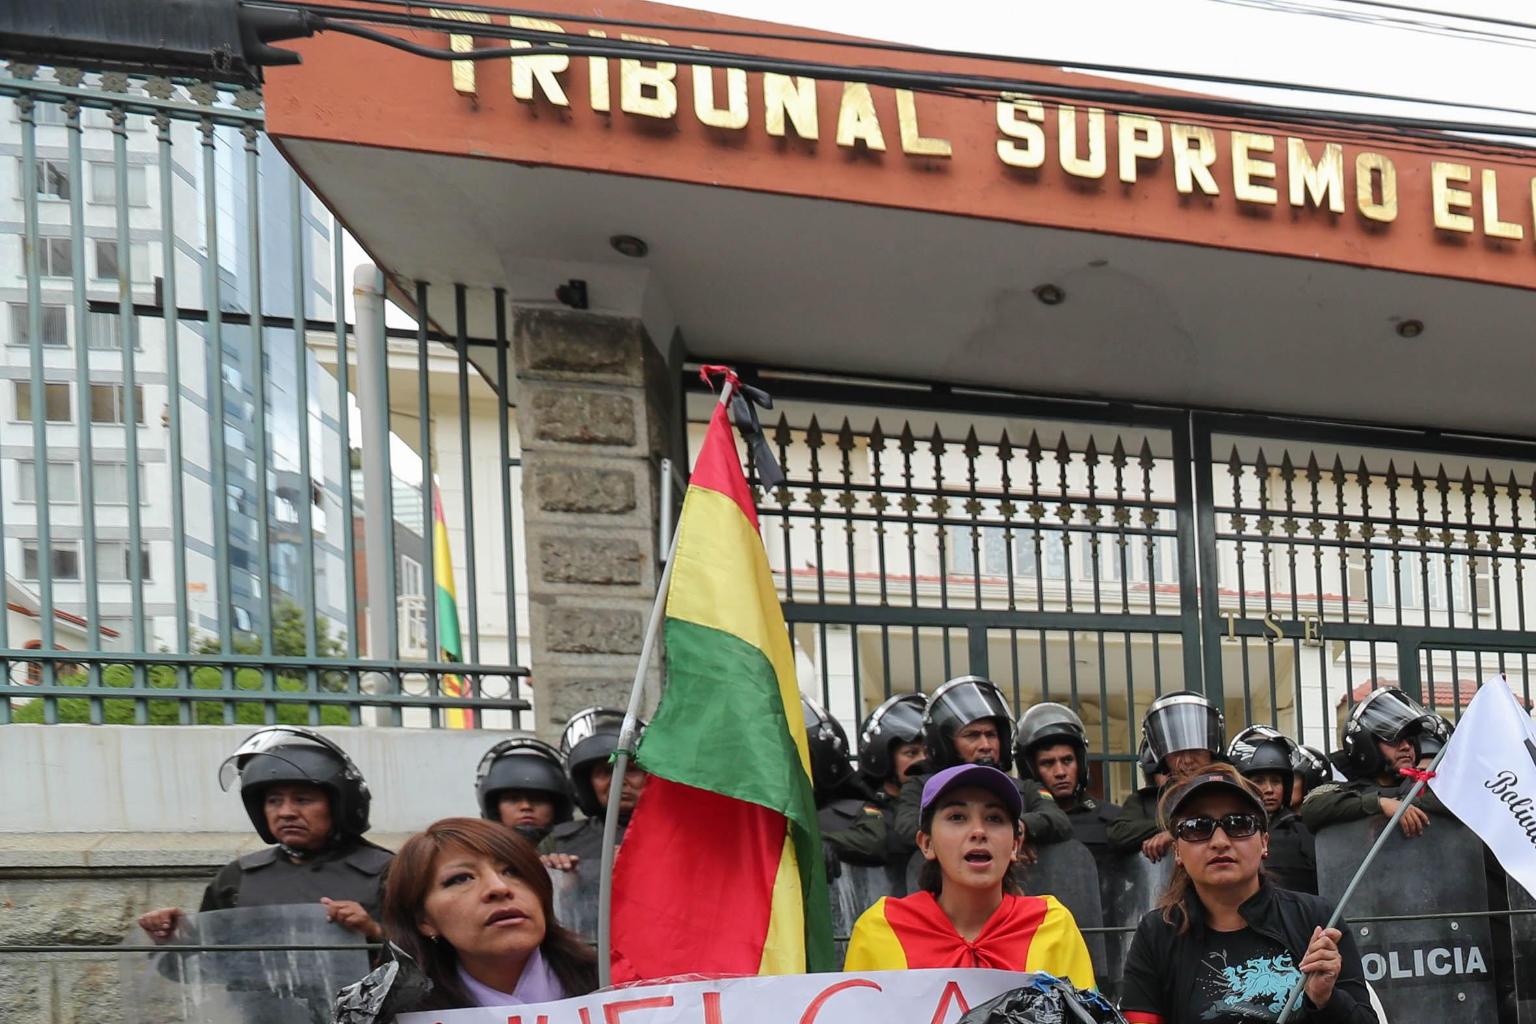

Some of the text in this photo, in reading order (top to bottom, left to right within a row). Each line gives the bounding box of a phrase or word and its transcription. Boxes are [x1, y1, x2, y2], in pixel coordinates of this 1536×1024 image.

[430, 8, 952, 157] TRIBUNAL
[997, 92, 1397, 223] SUPREMO
[1360, 946, 1488, 981] OLICIA
